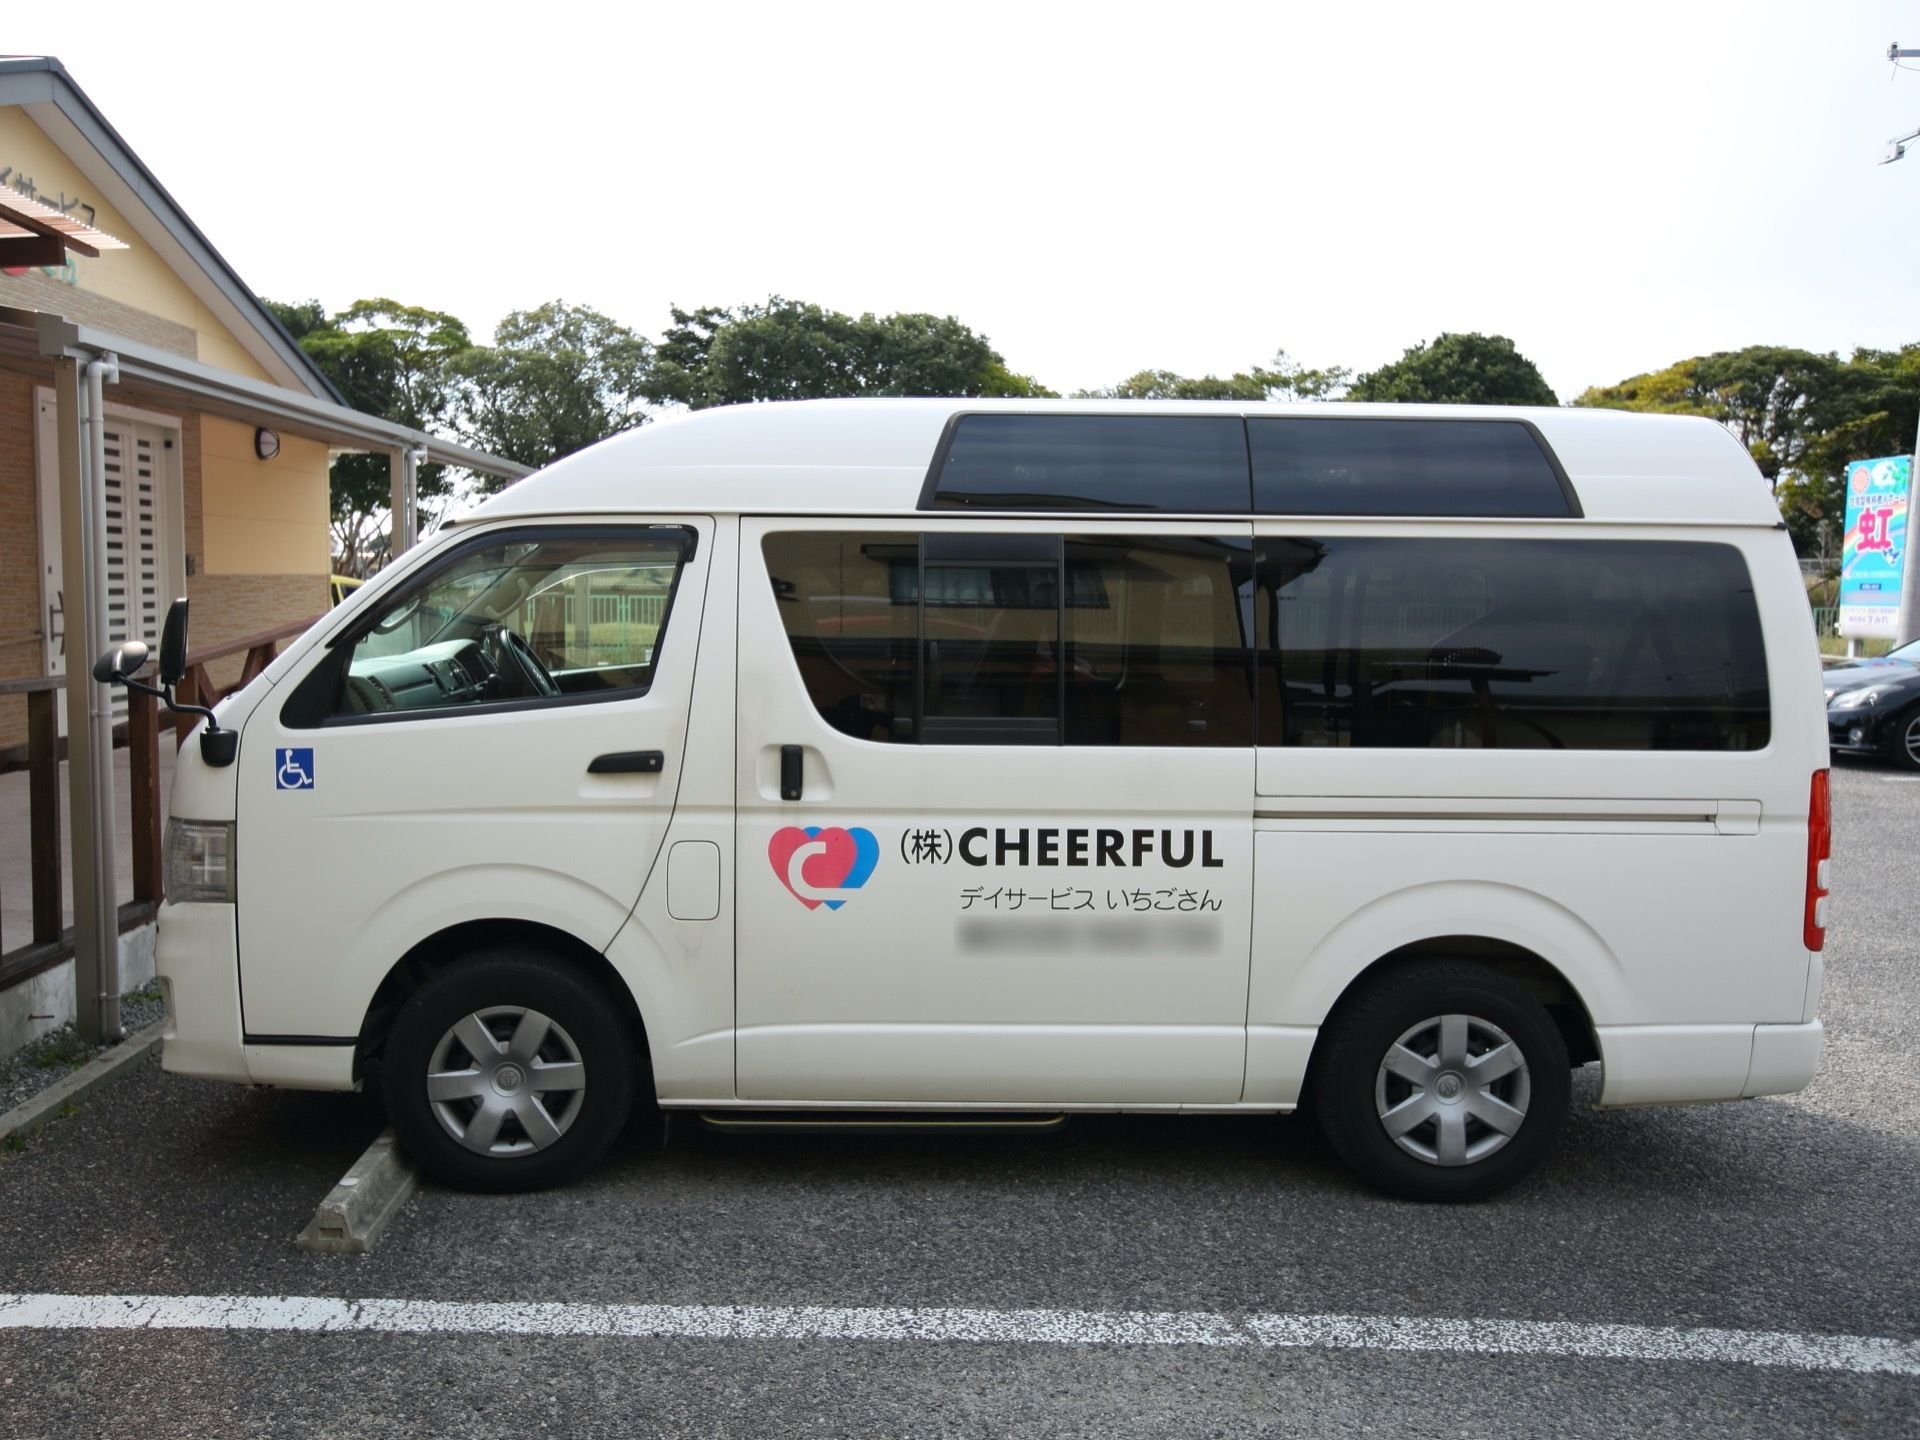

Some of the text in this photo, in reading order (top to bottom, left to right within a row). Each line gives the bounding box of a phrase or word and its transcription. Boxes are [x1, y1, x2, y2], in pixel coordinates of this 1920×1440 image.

[1857, 507, 1893, 551] 虹
[960, 886, 1223, 912] デイサービス いちごさん
